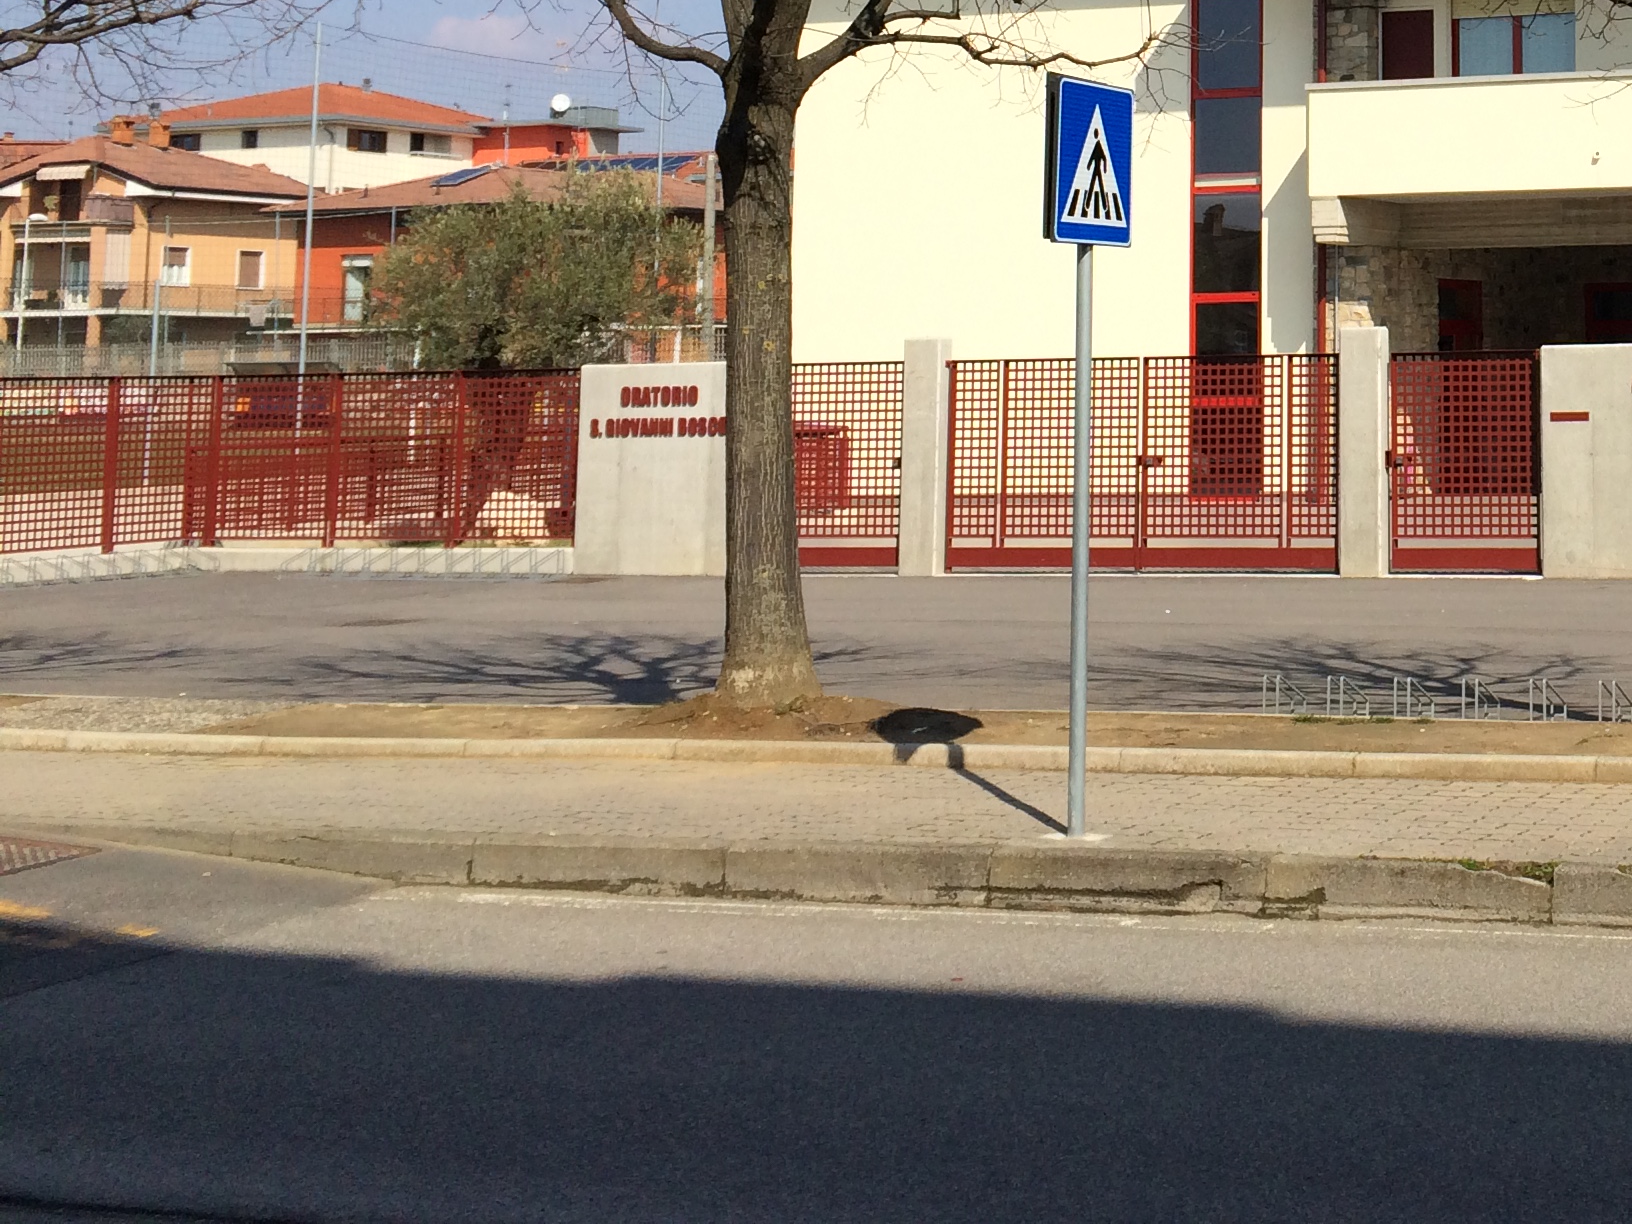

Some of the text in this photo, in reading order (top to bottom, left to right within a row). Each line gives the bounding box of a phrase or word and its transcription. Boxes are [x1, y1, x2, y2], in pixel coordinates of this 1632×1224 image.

[620, 385, 699, 408] ORATORIO
[605, 418, 674, 439] GIOVANNI
[678, 416, 727, 438] BOSCO
